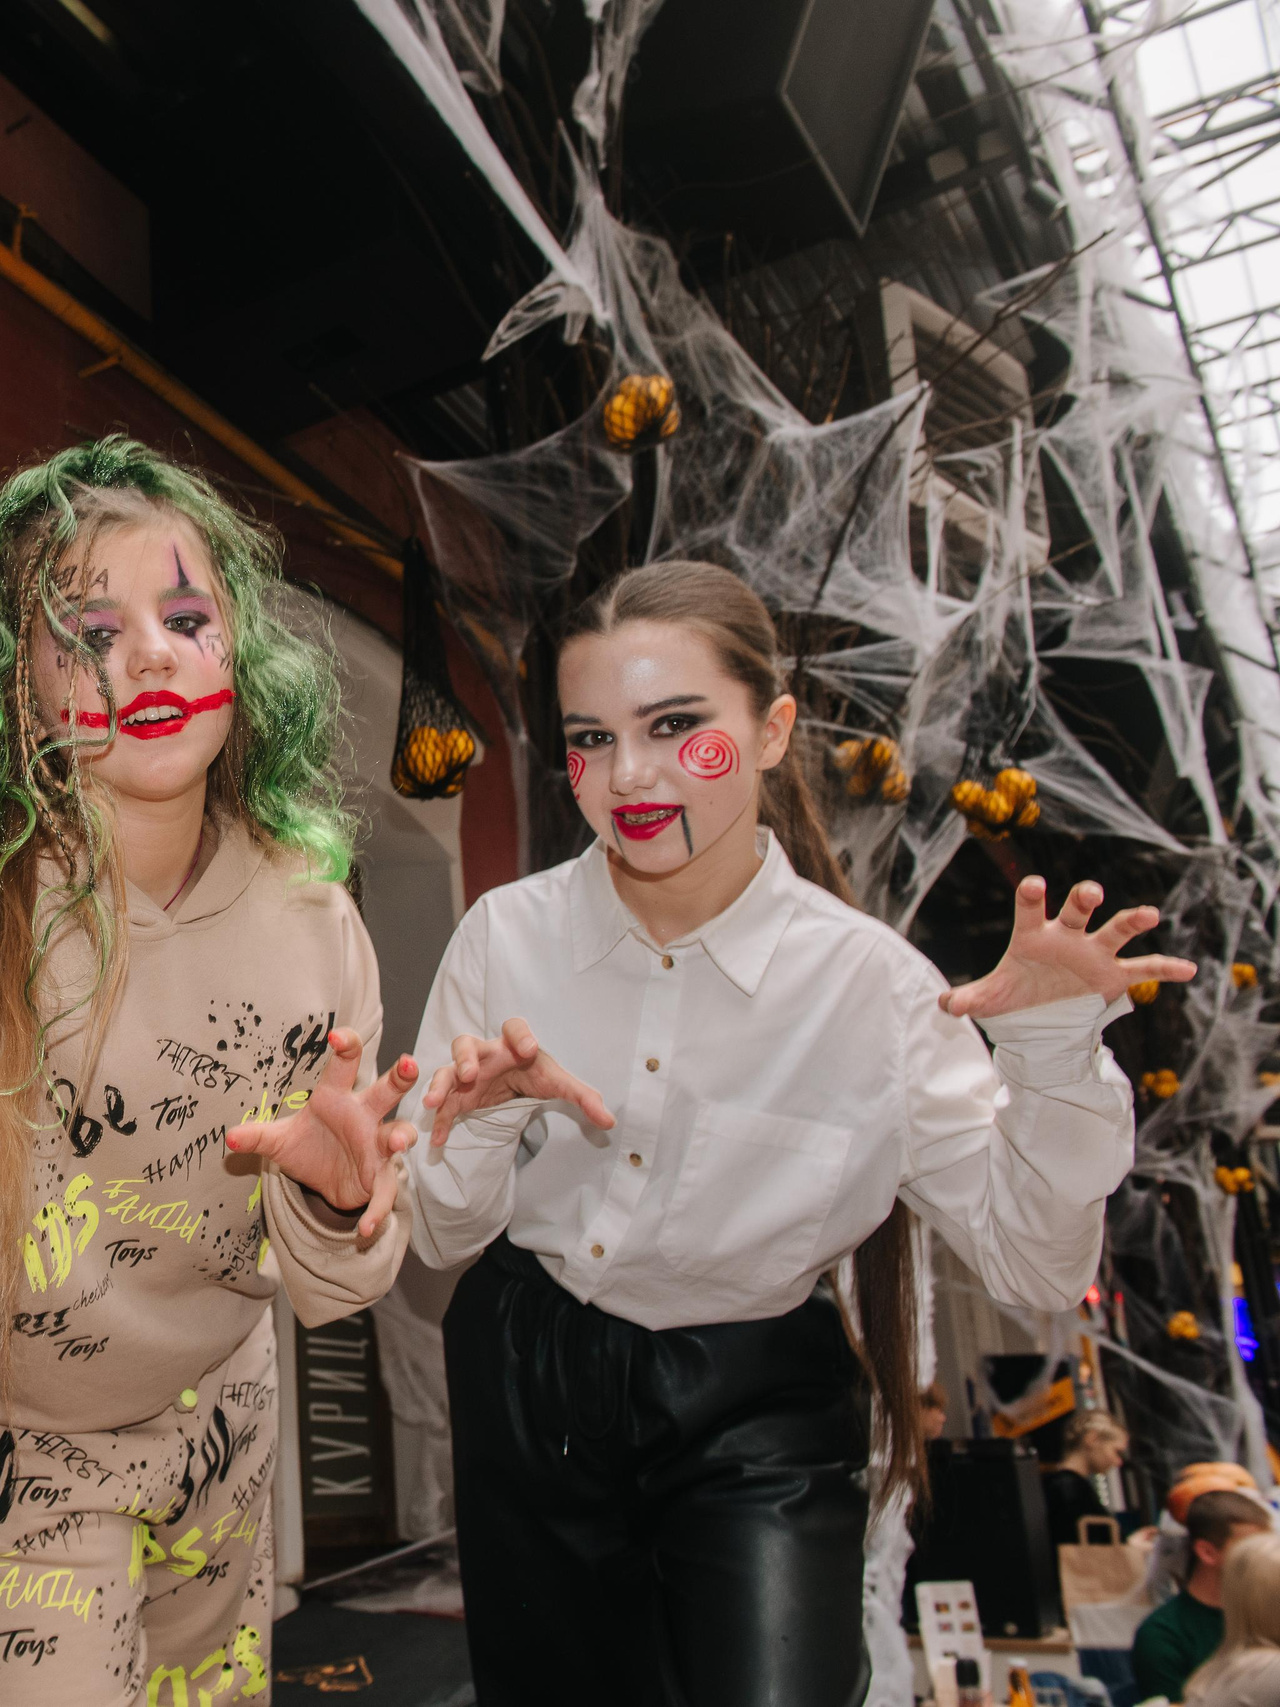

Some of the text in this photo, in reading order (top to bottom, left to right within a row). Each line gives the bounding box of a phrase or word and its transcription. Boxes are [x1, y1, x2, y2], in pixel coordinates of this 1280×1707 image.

[150, 1095, 199, 1131] Toys
[143, 1124, 226, 1184] Happy
[105, 1239, 159, 1269] Toys
[54, 1336, 110, 1362] Toys
[306, 1308, 372, 1495] КУРИЦ
[10, 1476, 72, 1509] Toys
[195, 1561, 230, 1587] oys
